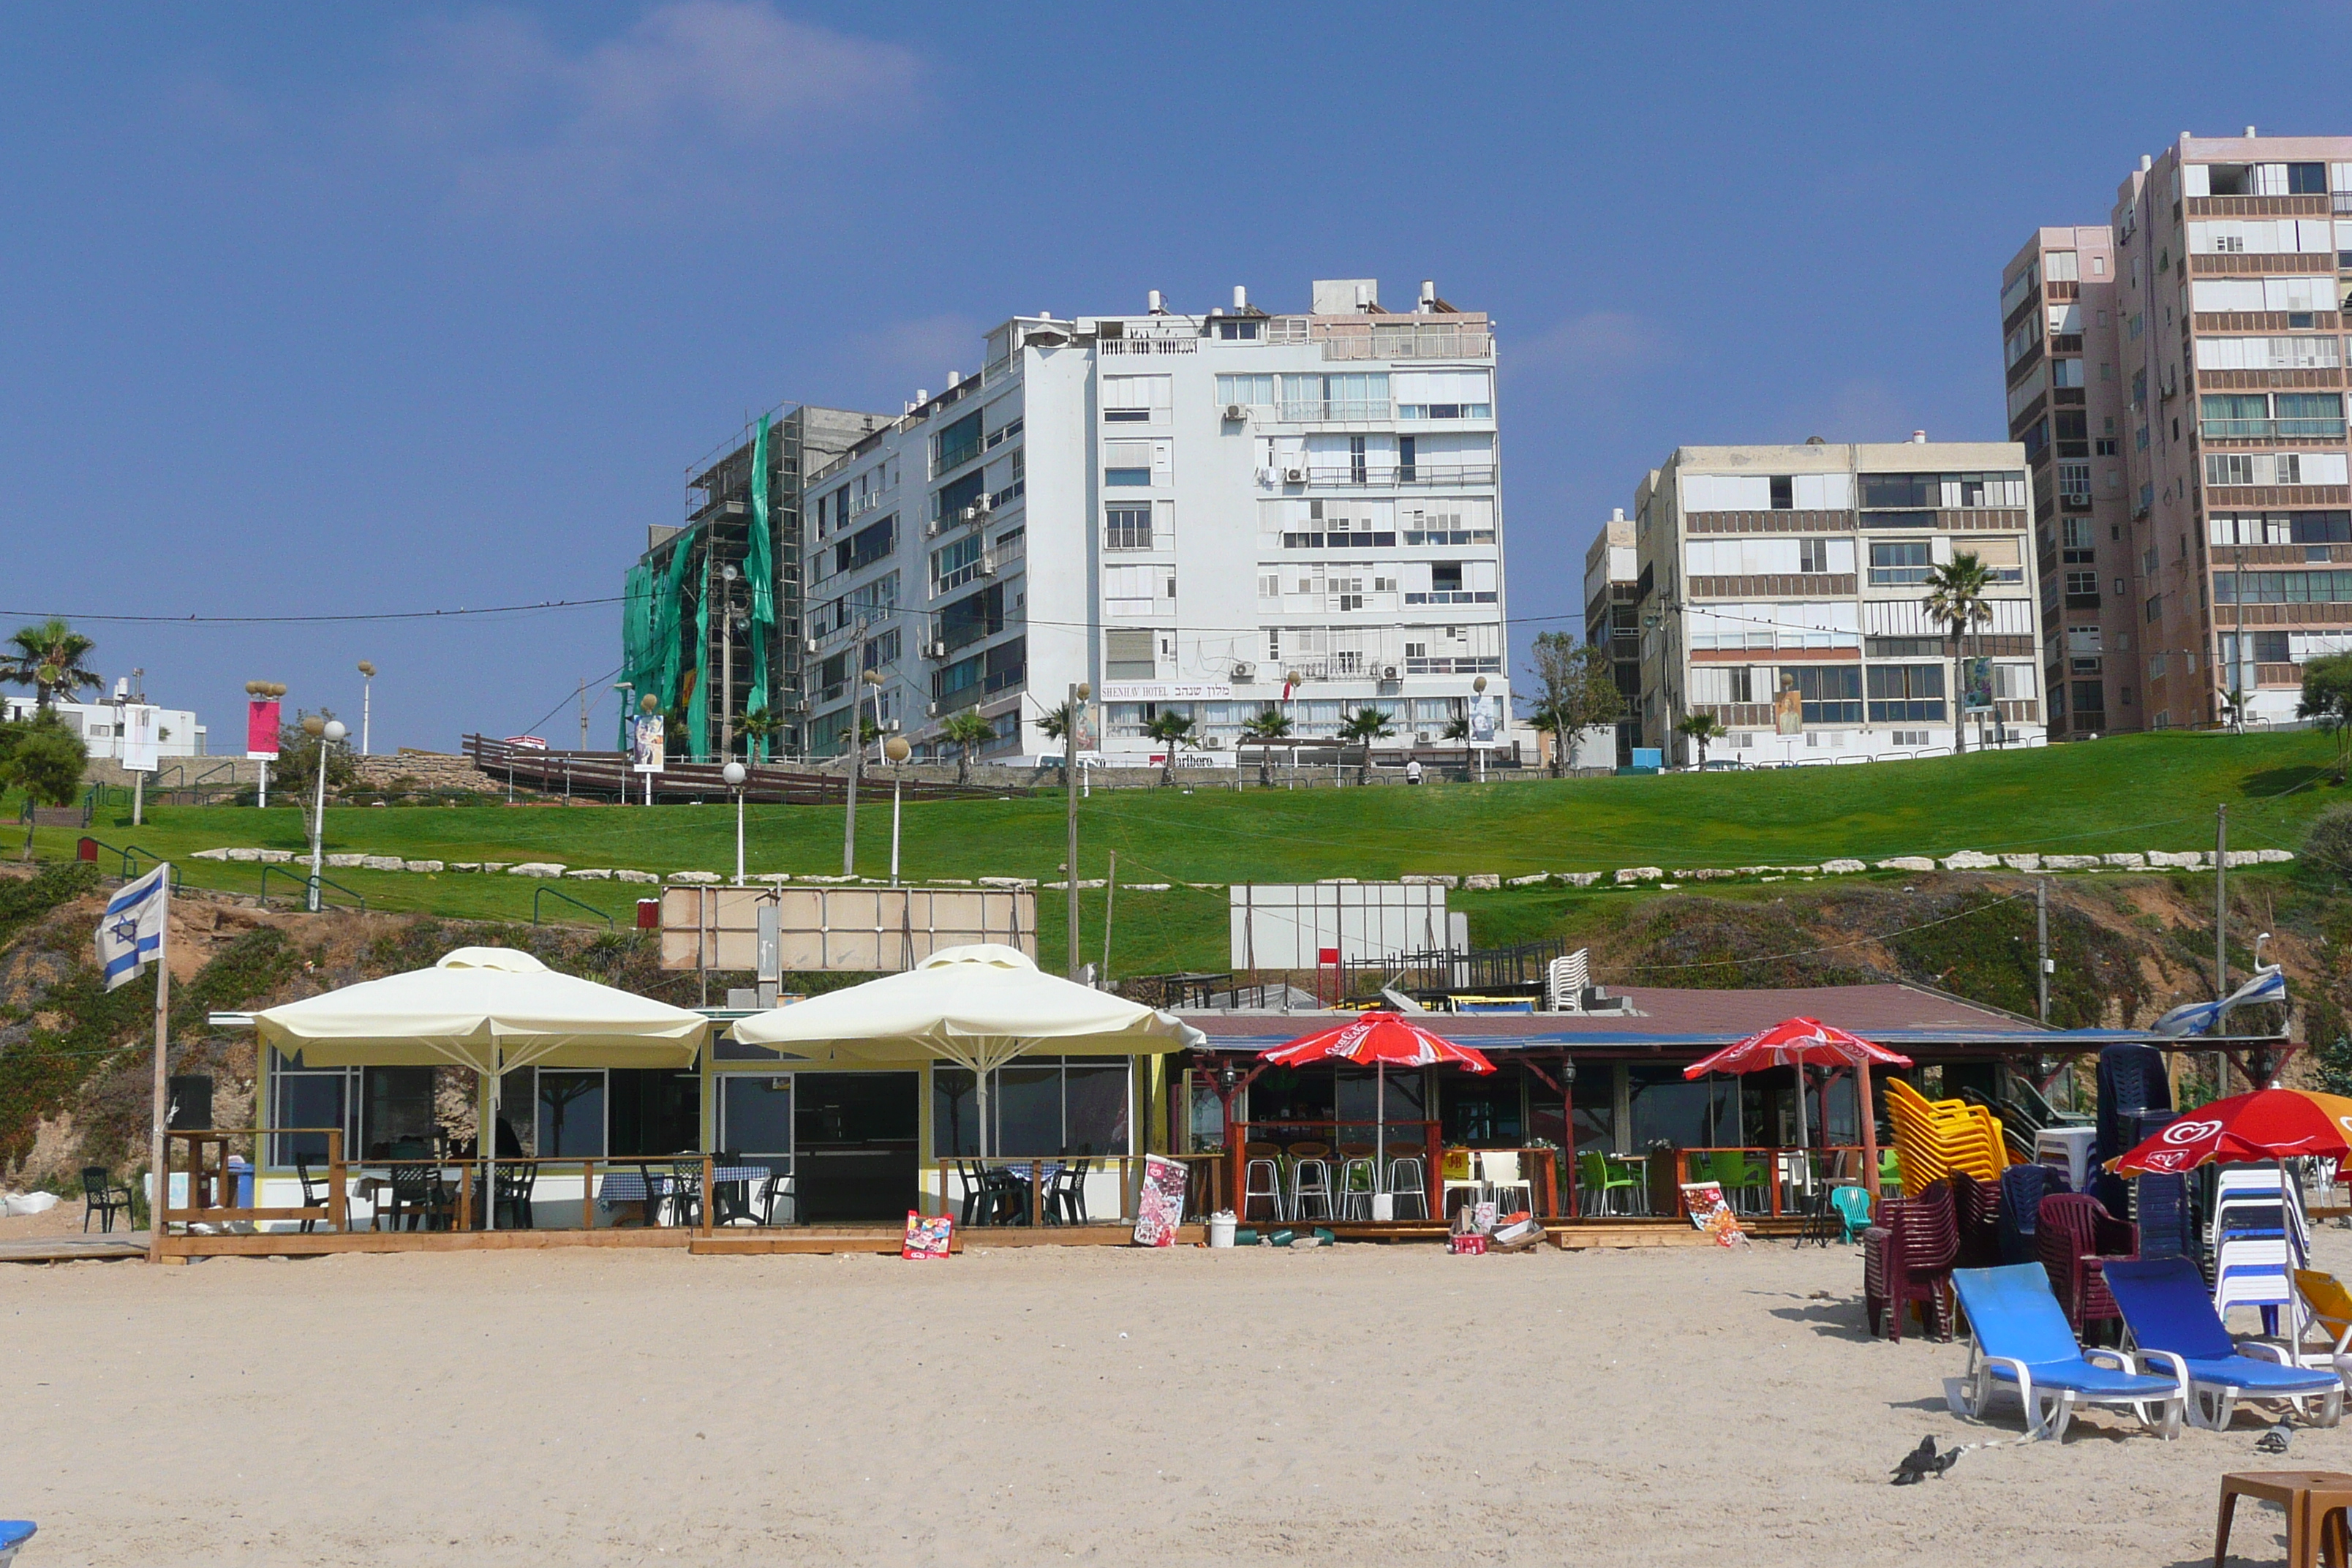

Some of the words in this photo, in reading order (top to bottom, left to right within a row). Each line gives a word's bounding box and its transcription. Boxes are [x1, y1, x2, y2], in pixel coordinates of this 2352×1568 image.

[1102, 687, 1139, 697] SHENHAV
[1143, 687, 1169, 696] HOTEL
[1175, 687, 1202, 696] שנהב
[1207, 683, 1229, 698] מלון
[1174, 755, 1213, 767] arlboro
[1448, 1156, 1462, 1169] J&B
